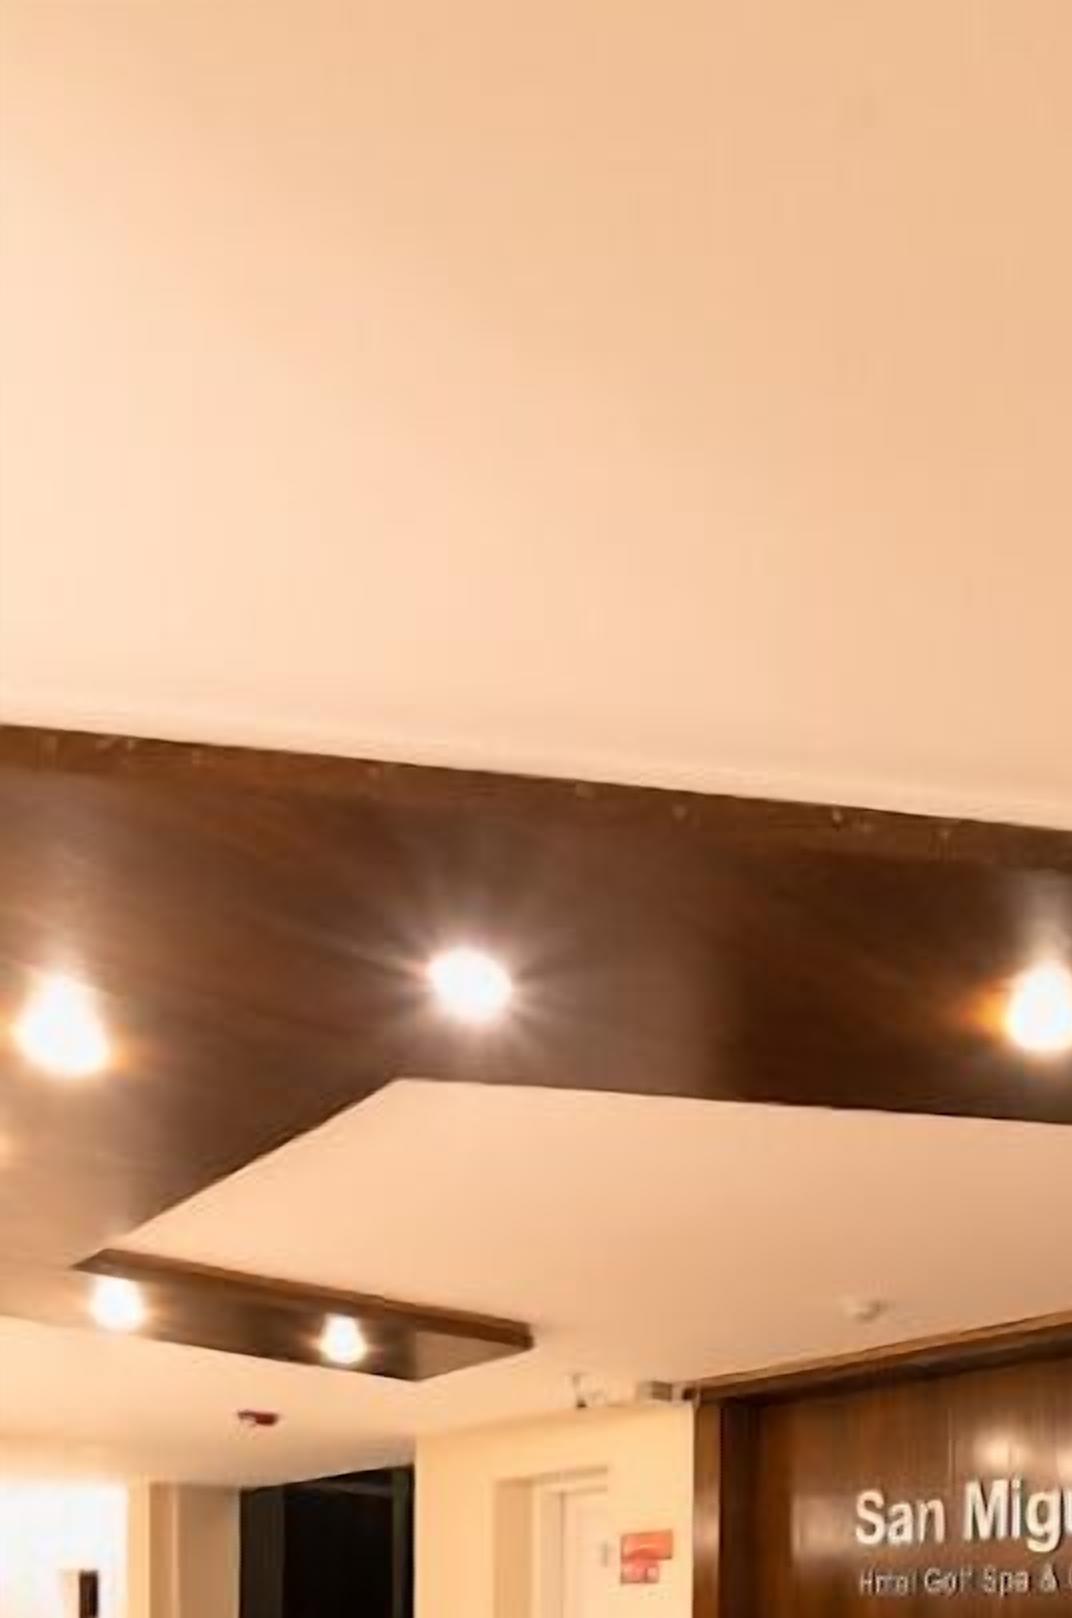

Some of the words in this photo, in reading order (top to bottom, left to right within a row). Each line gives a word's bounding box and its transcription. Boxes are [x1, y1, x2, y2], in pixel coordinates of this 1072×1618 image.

[855, 1490, 945, 1545] San
[983, 1564, 1030, 1596] Spa
[1040, 1562, 1060, 1593] &
